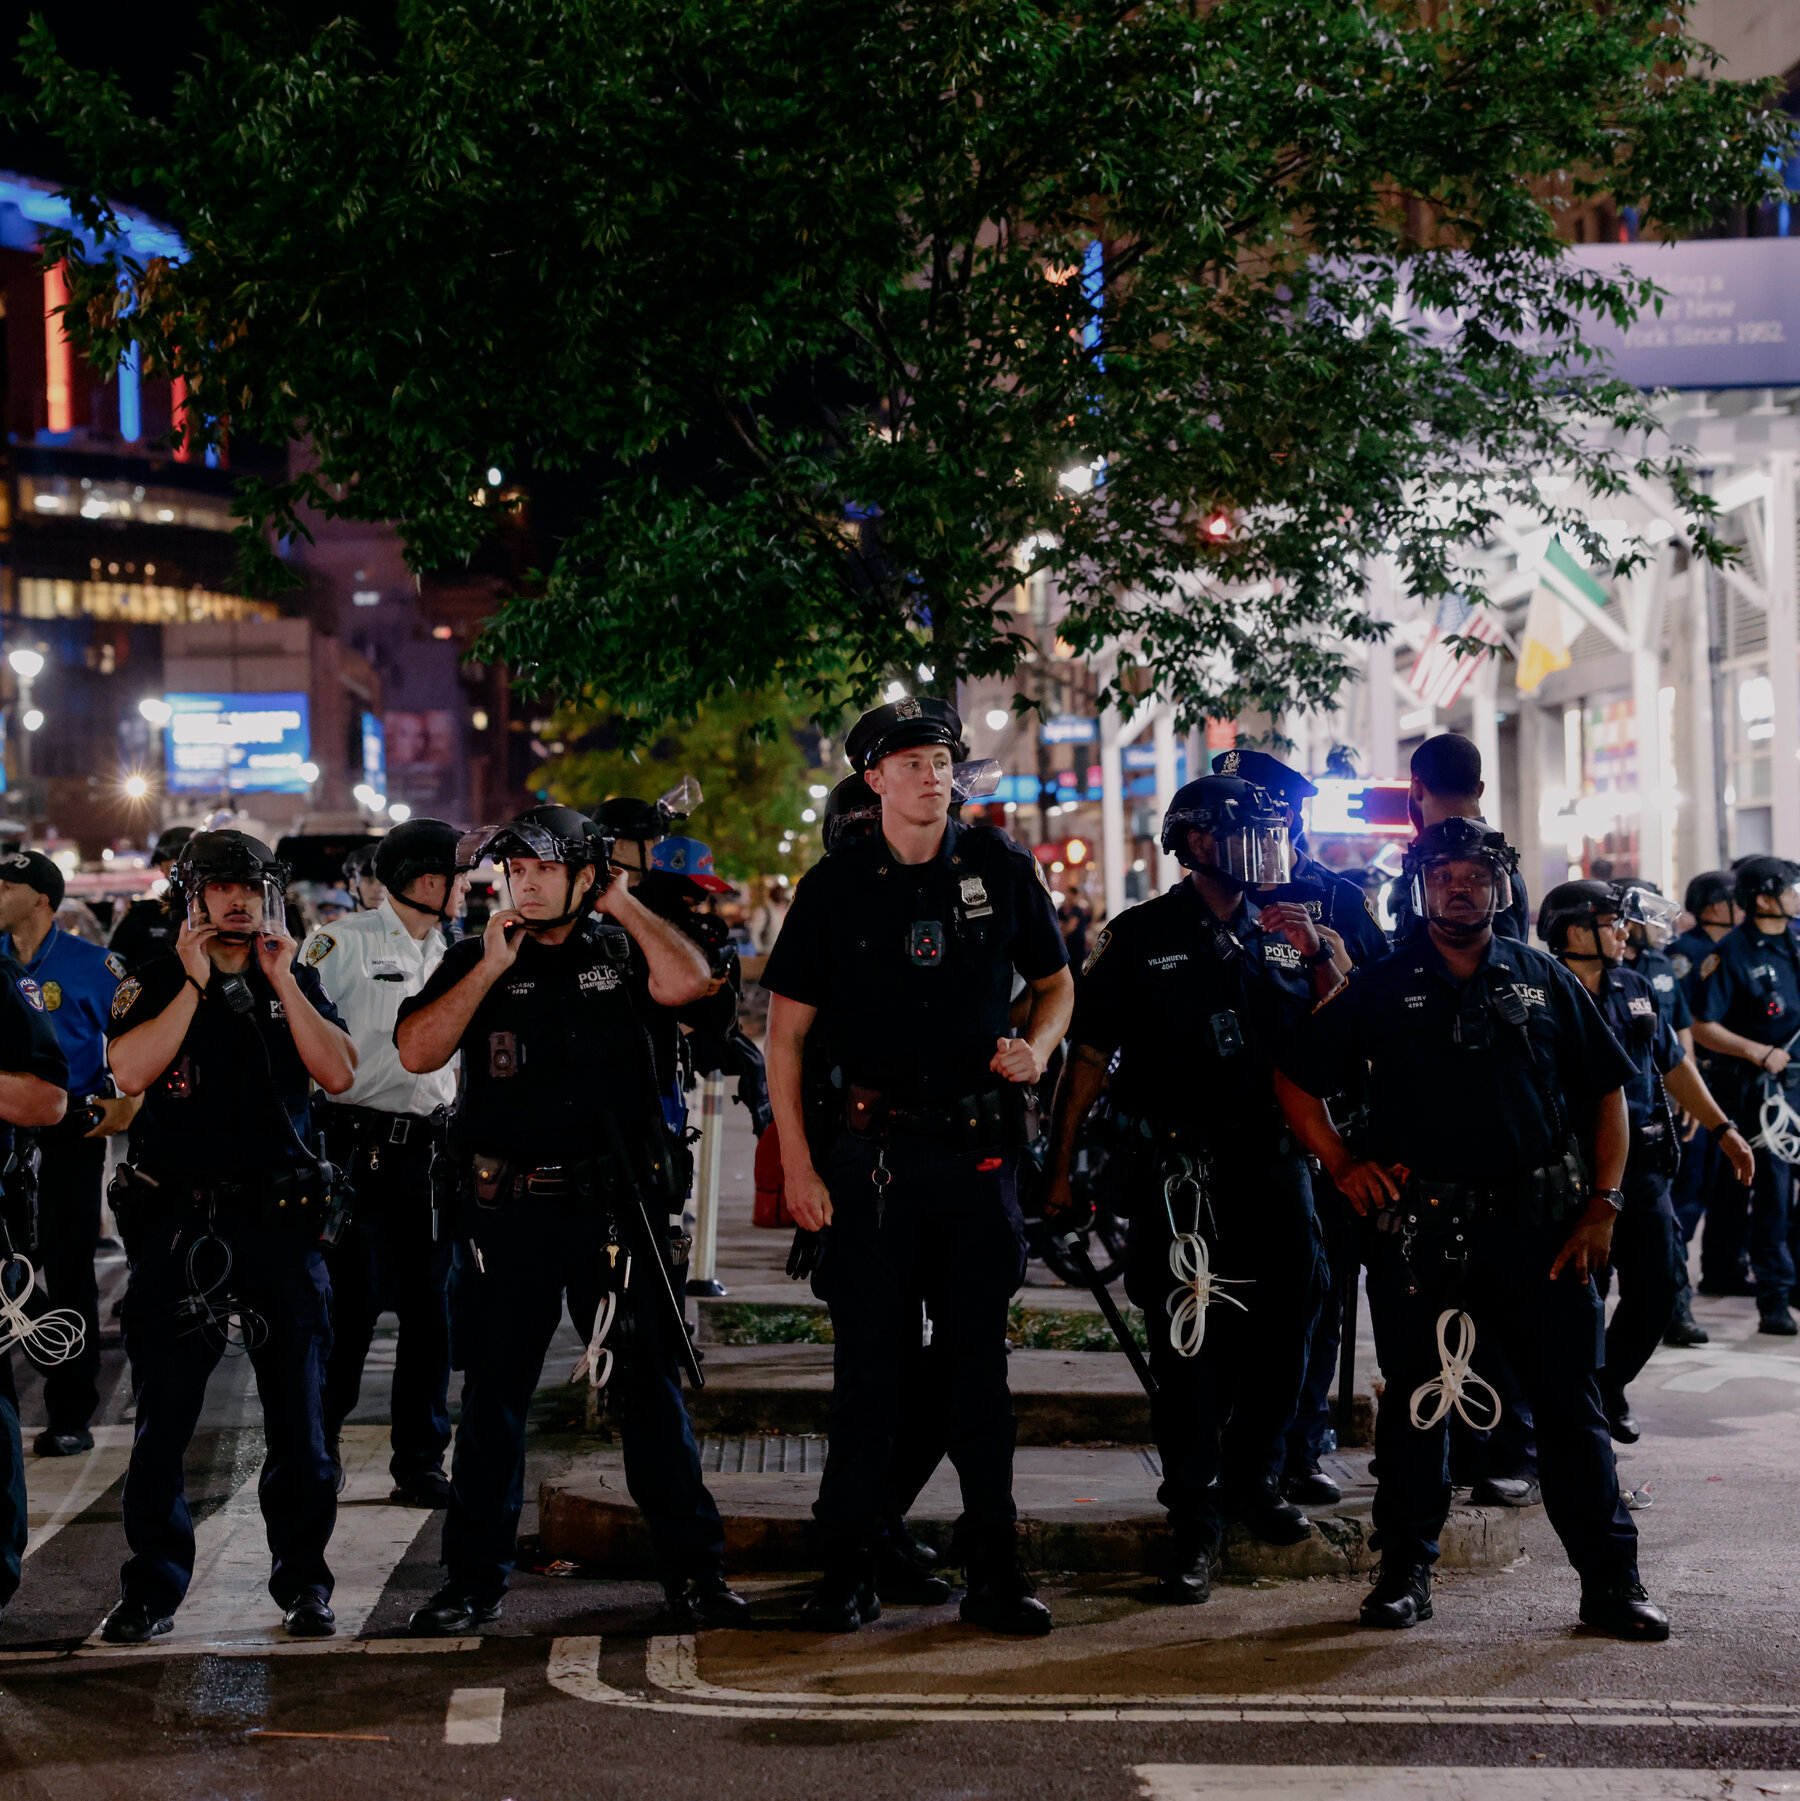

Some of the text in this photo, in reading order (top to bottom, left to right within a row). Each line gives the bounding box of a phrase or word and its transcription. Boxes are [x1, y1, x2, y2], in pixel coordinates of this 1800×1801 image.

[1264, 945, 1302, 960] POLIC
[1147, 953, 1189, 967] VILLANUEVA
[1161, 962, 1177, 970] 4041
